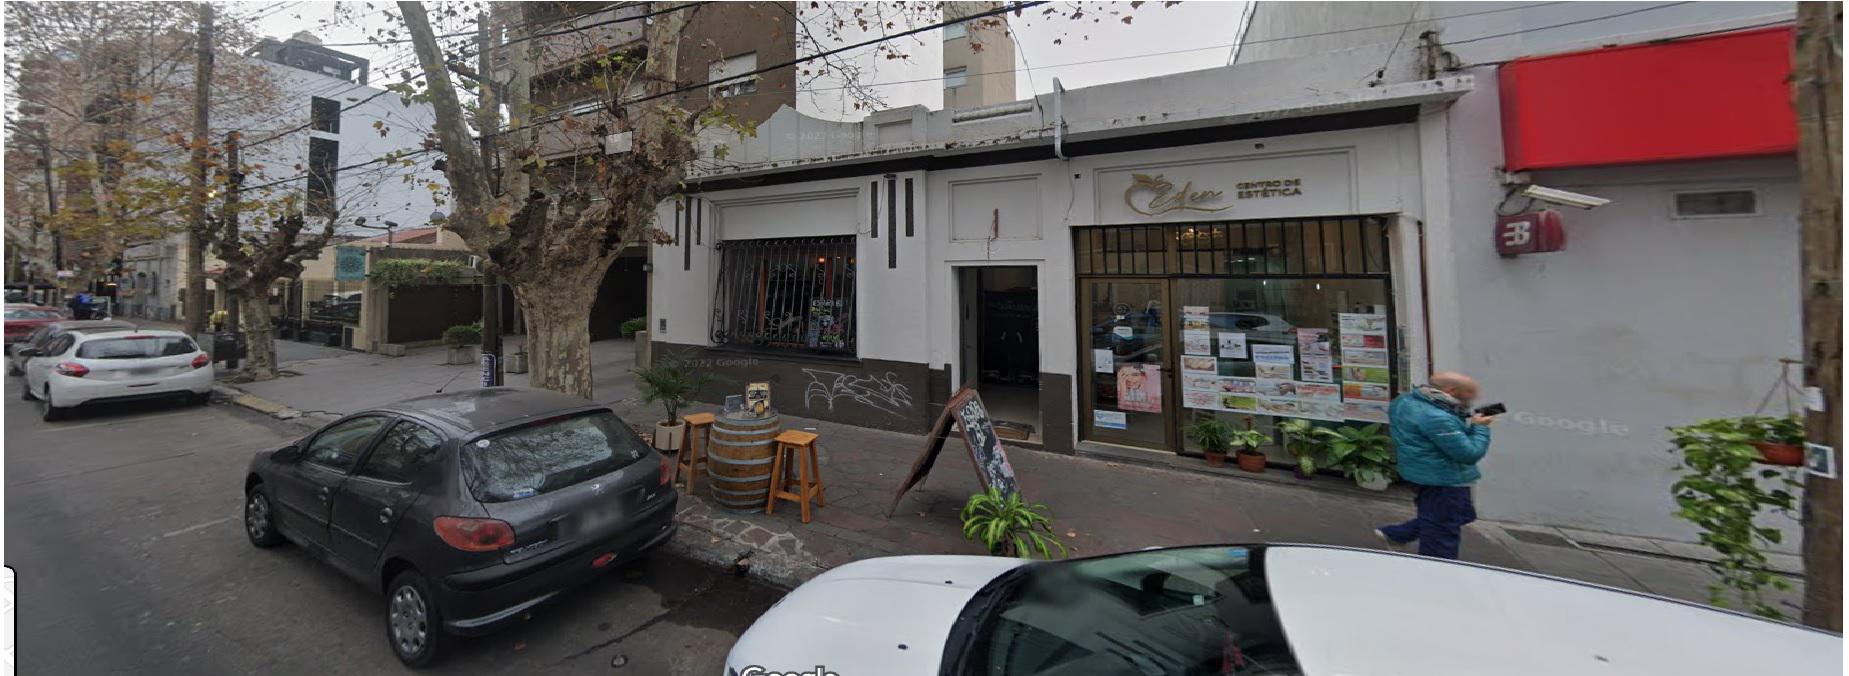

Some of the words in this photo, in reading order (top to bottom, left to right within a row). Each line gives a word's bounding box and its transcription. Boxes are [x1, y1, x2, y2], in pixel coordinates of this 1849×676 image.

[1235, 180, 1281, 189] CENTRO
[1284, 178, 1301, 187] DE
[1149, 181, 1222, 208] Eden
